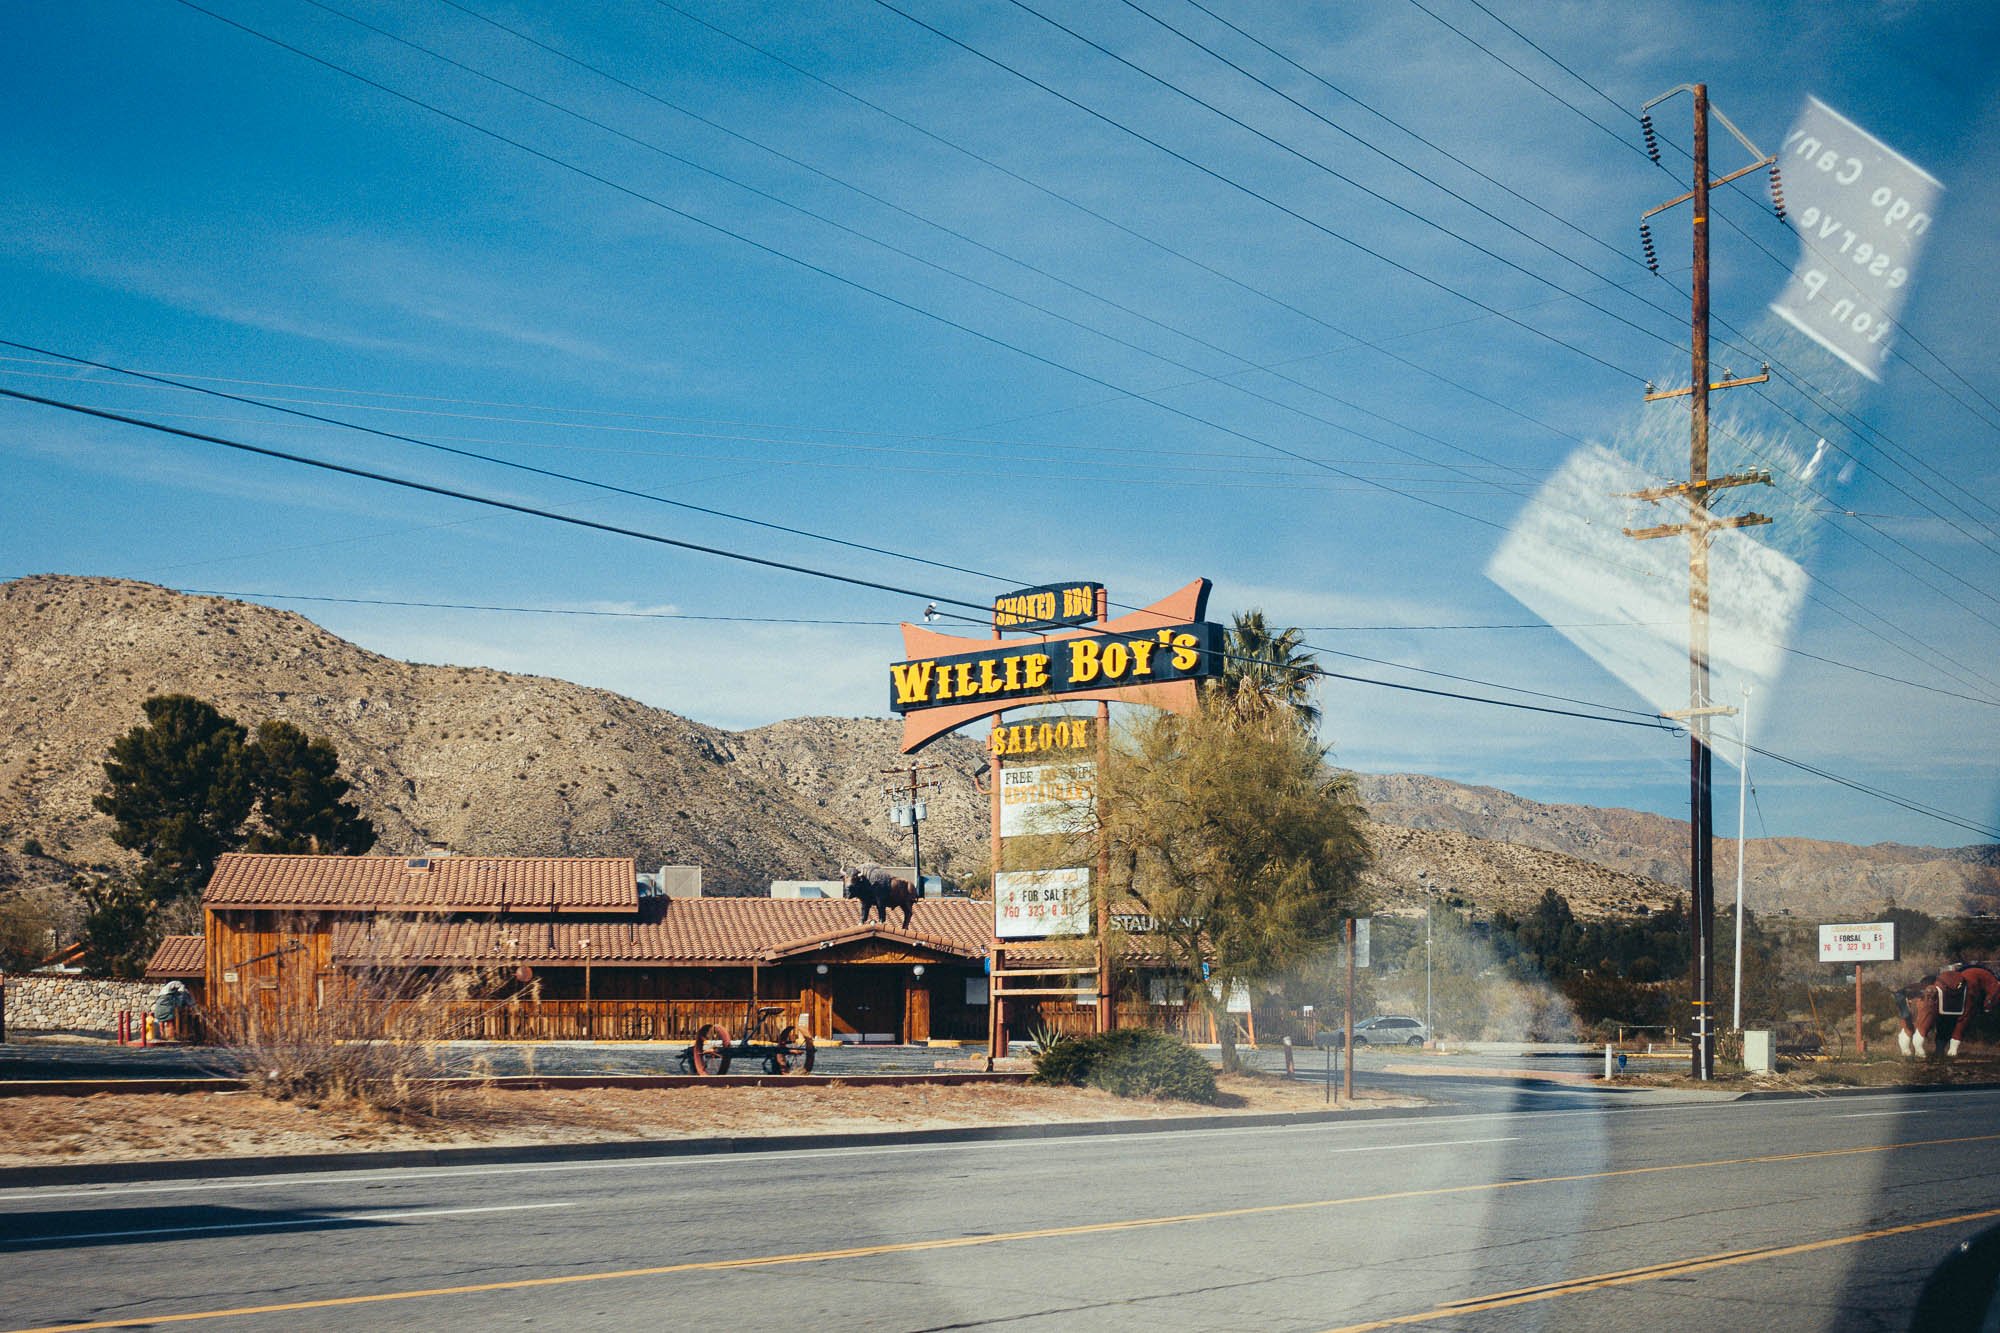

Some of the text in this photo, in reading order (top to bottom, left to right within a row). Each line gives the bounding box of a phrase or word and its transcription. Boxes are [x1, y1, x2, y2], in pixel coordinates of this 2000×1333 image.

[996, 585, 1093, 626] SMOKED BBQ
[891, 629, 1200, 704] WILLIE BOY'S
[992, 720, 1088, 755] SALOON
[1005, 771, 1034, 784] FREE
[1022, 889, 1039, 902] FOR
[1004, 905, 1020, 918] 760
[1028, 904, 1045, 917] 323
